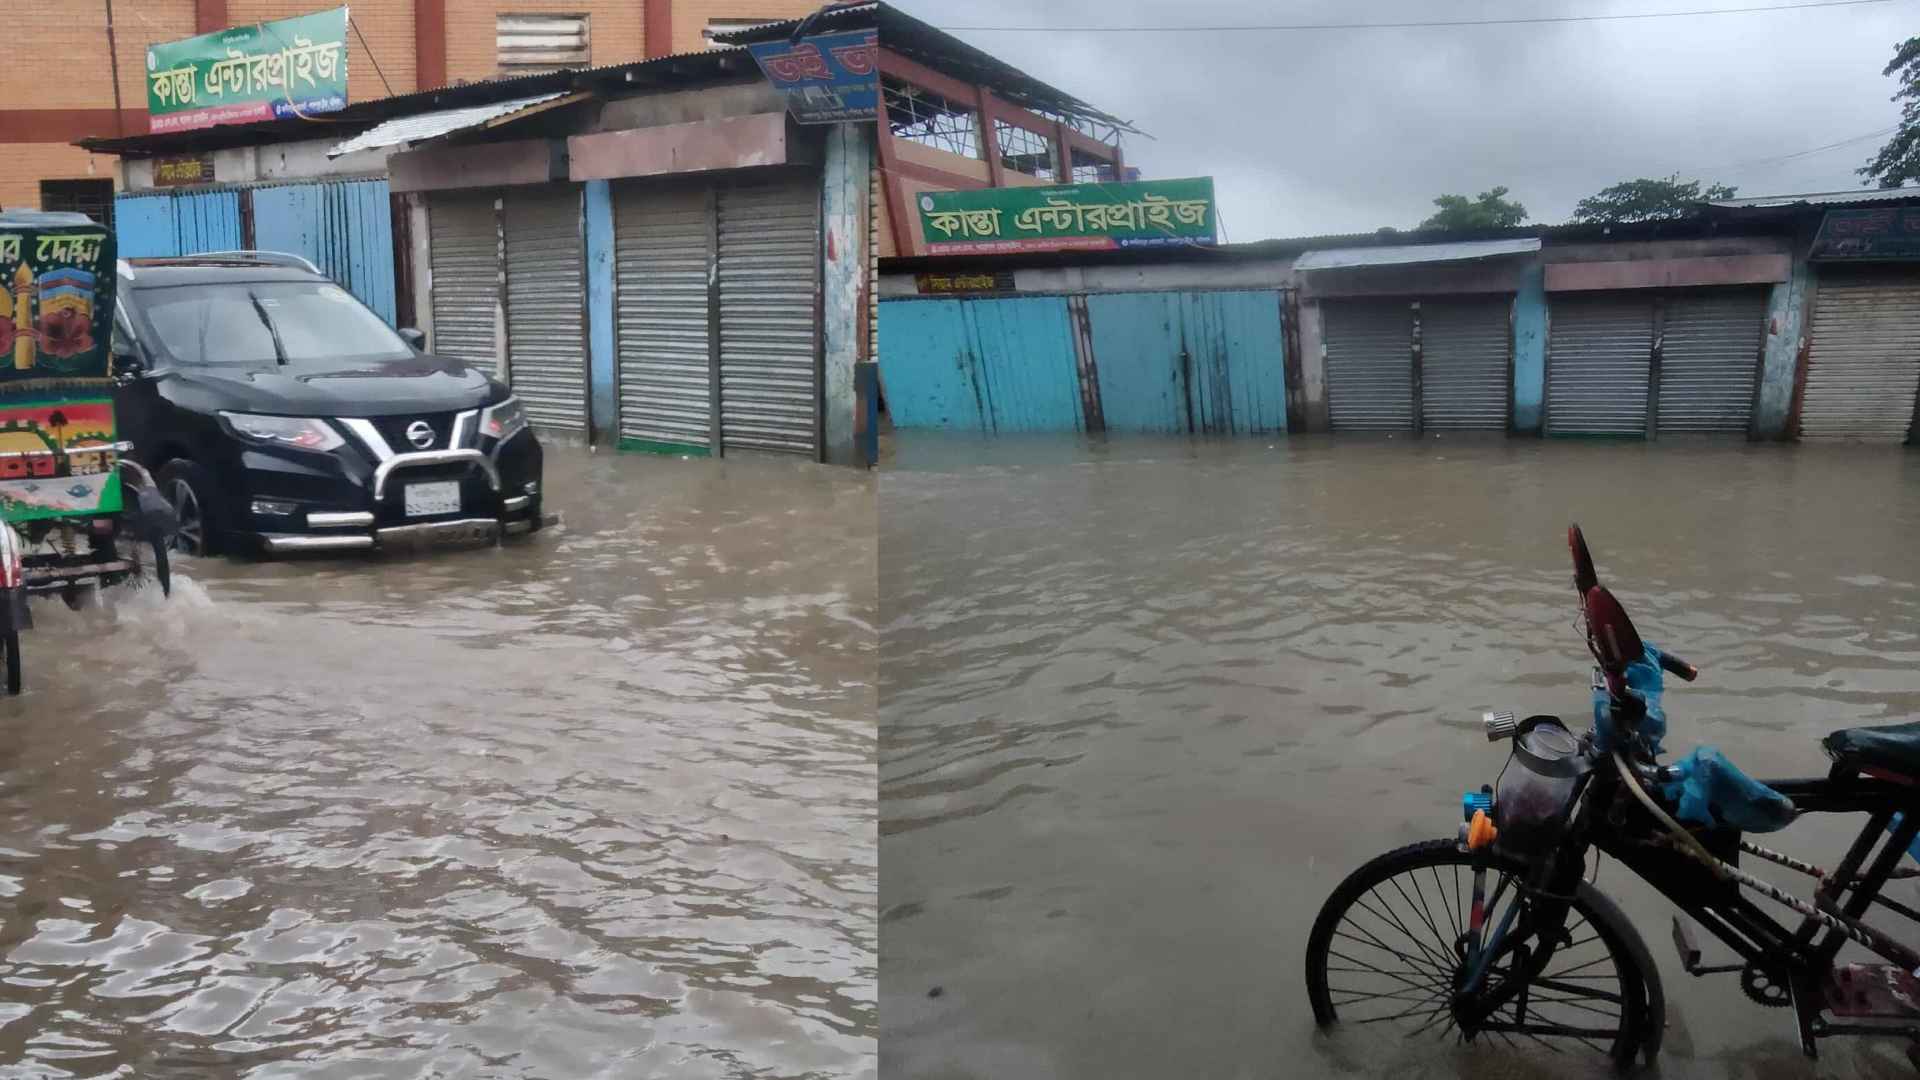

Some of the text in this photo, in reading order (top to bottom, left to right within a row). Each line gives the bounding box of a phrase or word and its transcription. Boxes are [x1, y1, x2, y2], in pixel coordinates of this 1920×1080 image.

[150, 36, 342, 107] কান্তা এন্টারপ্রাইজ
[926, 192, 1209, 237] কান্তা এন্টারপ্রাইজ
